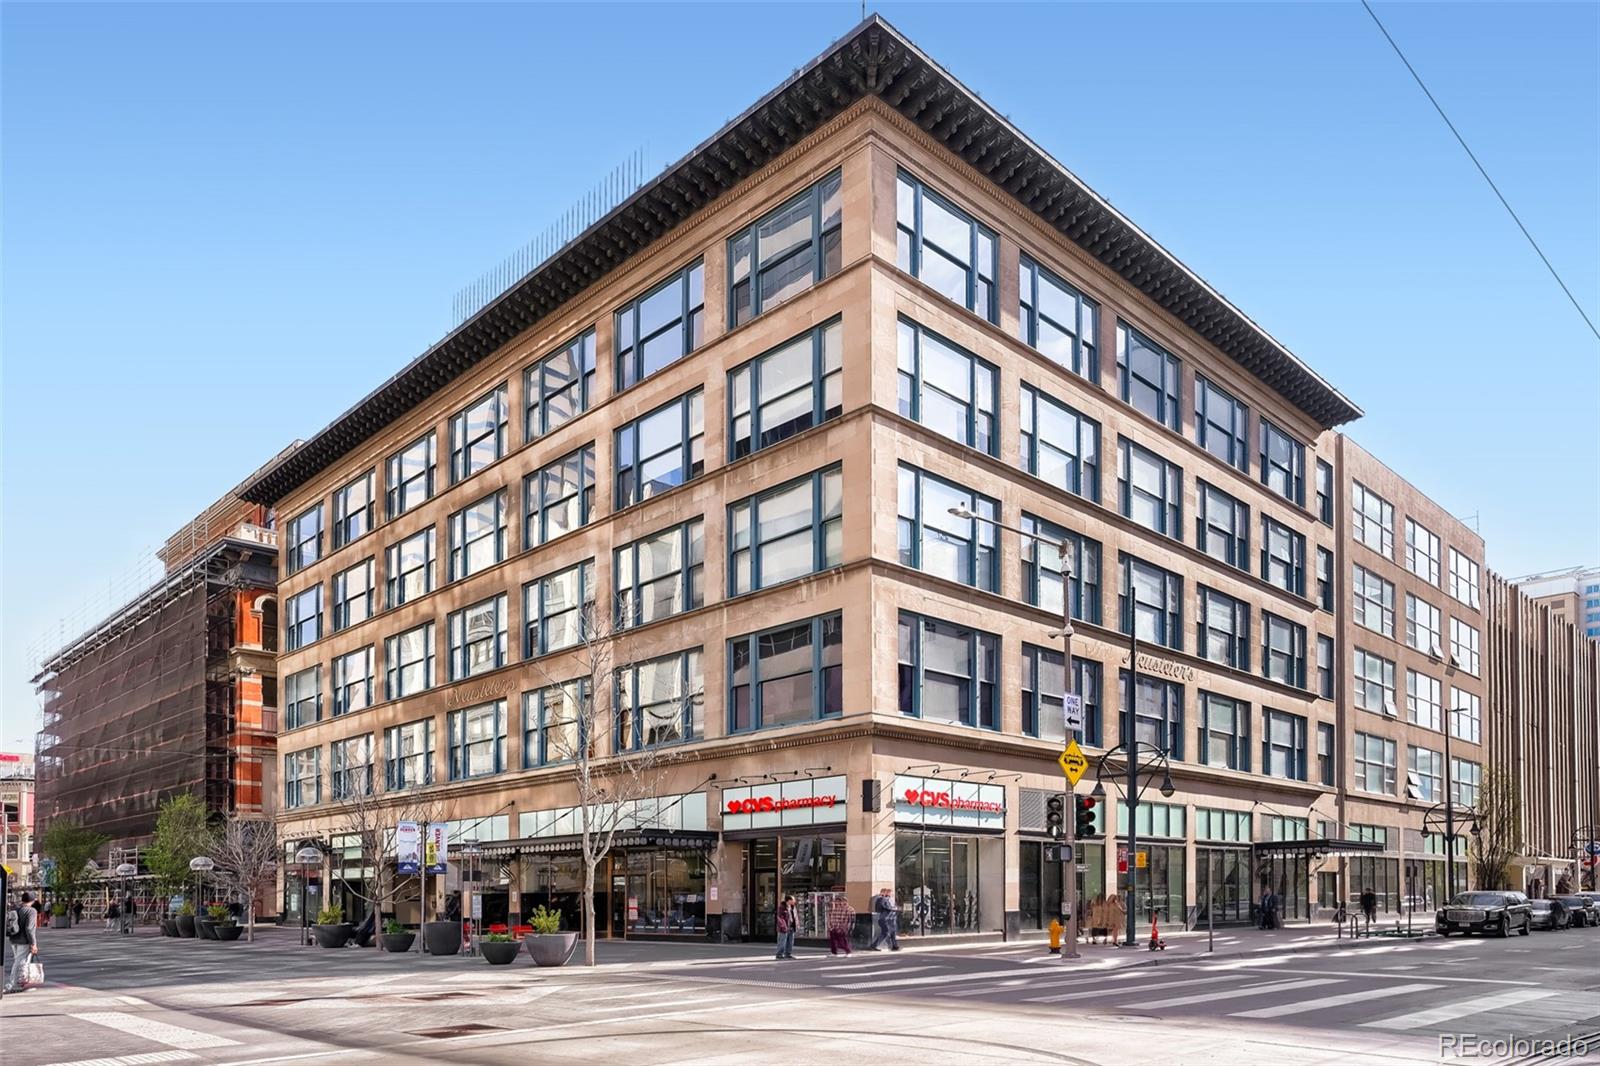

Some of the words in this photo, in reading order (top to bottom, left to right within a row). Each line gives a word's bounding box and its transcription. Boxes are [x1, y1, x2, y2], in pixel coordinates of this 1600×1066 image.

[1066, 696, 1079, 707] ONE
[1067, 706, 1079, 715] WAY
[742, 796, 774, 814] CVS
[774, 794, 836, 813] pharmacy
[919, 790, 950, 808] CVS
[951, 796, 1001, 815] pharmacy
